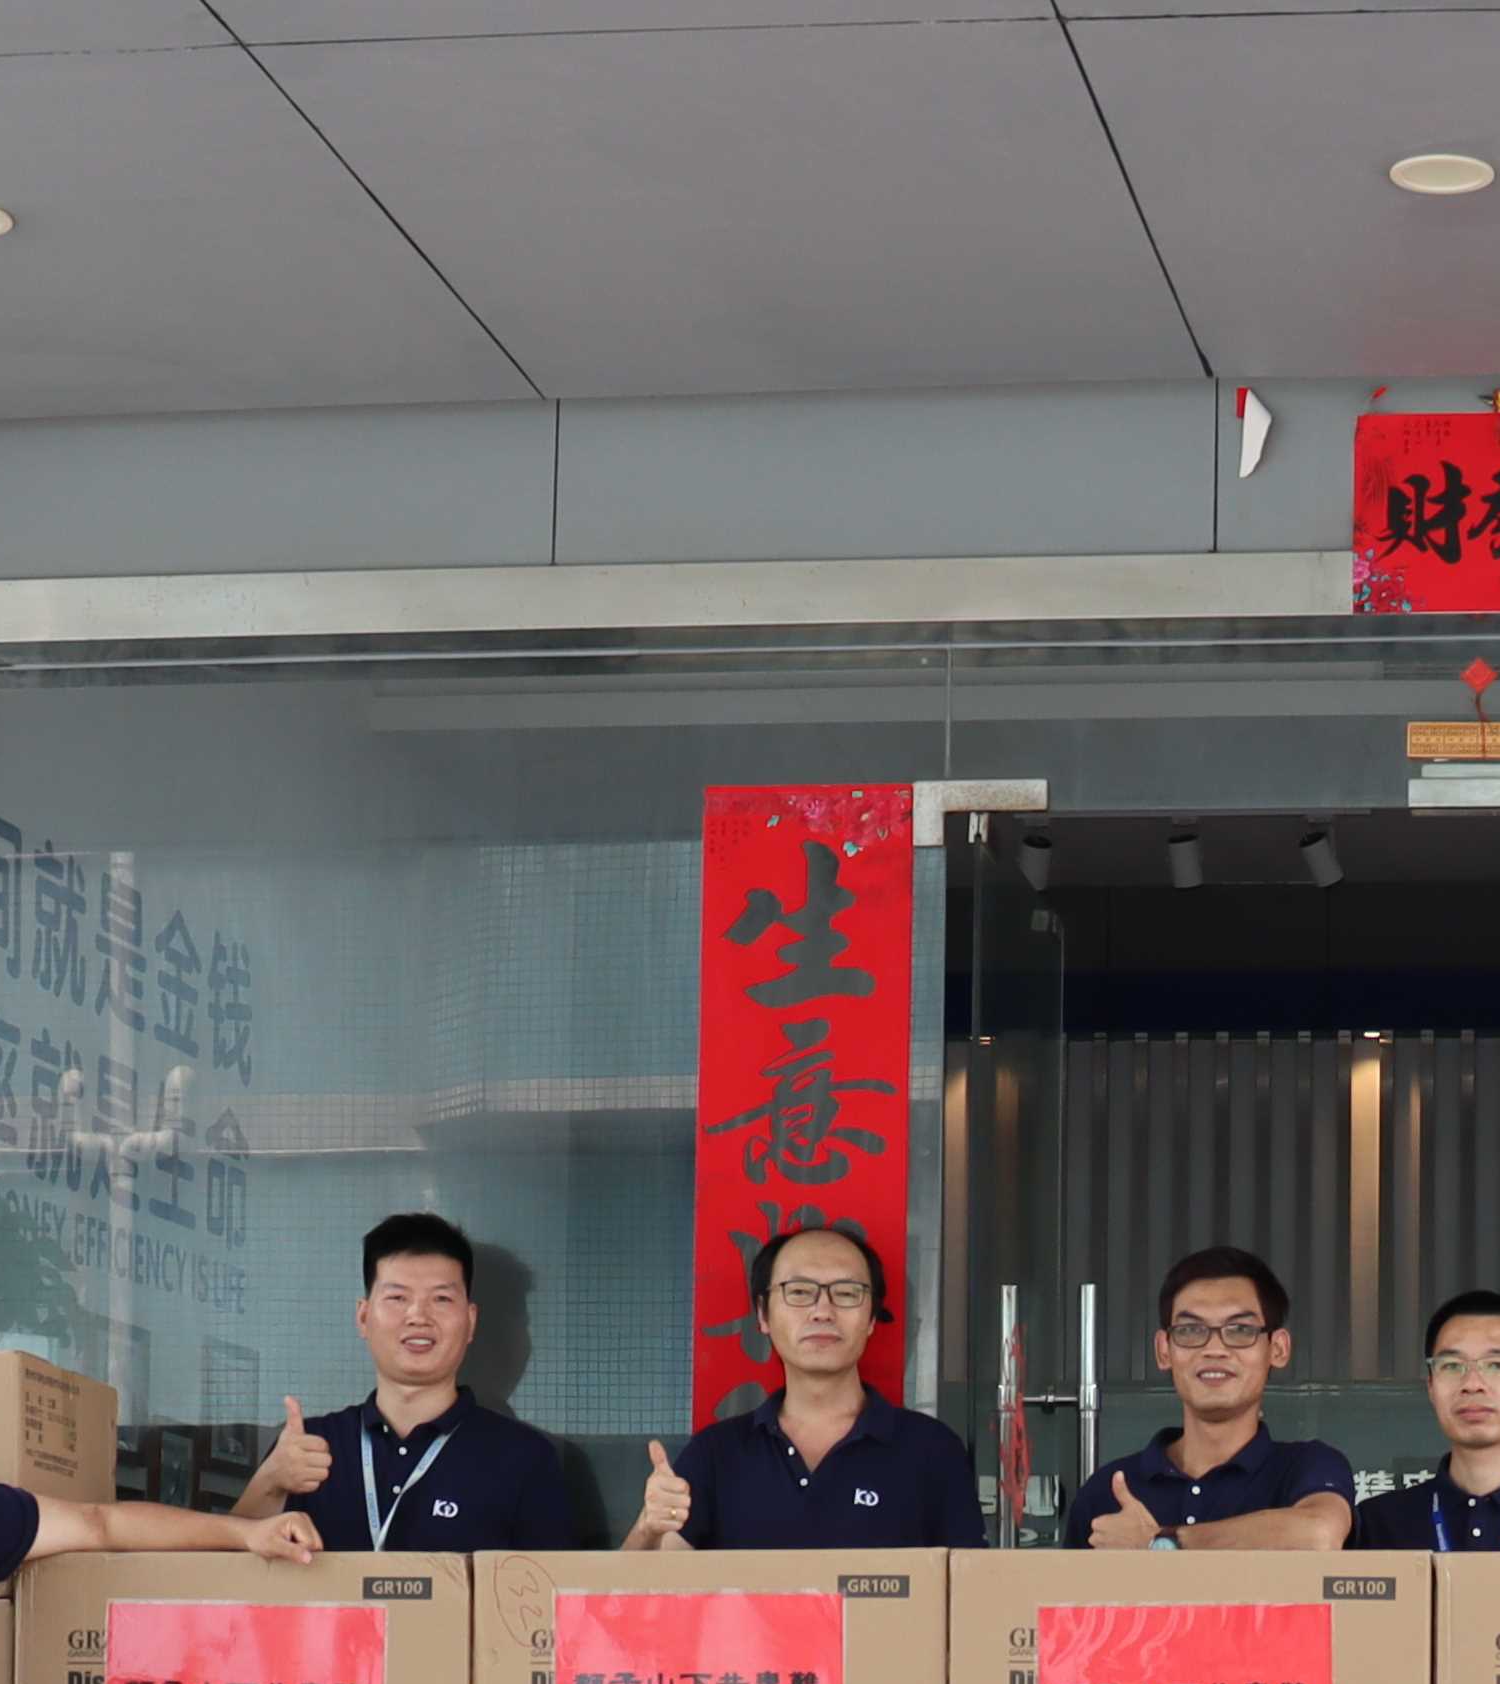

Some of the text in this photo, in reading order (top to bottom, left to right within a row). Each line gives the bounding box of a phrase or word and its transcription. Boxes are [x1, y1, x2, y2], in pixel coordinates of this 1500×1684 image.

[372, 1579, 424, 1597] GR100
[847, 1578, 900, 1594] GR100
[1332, 1580, 1387, 1596] GR100
[68, 1630, 105, 1650] GR
